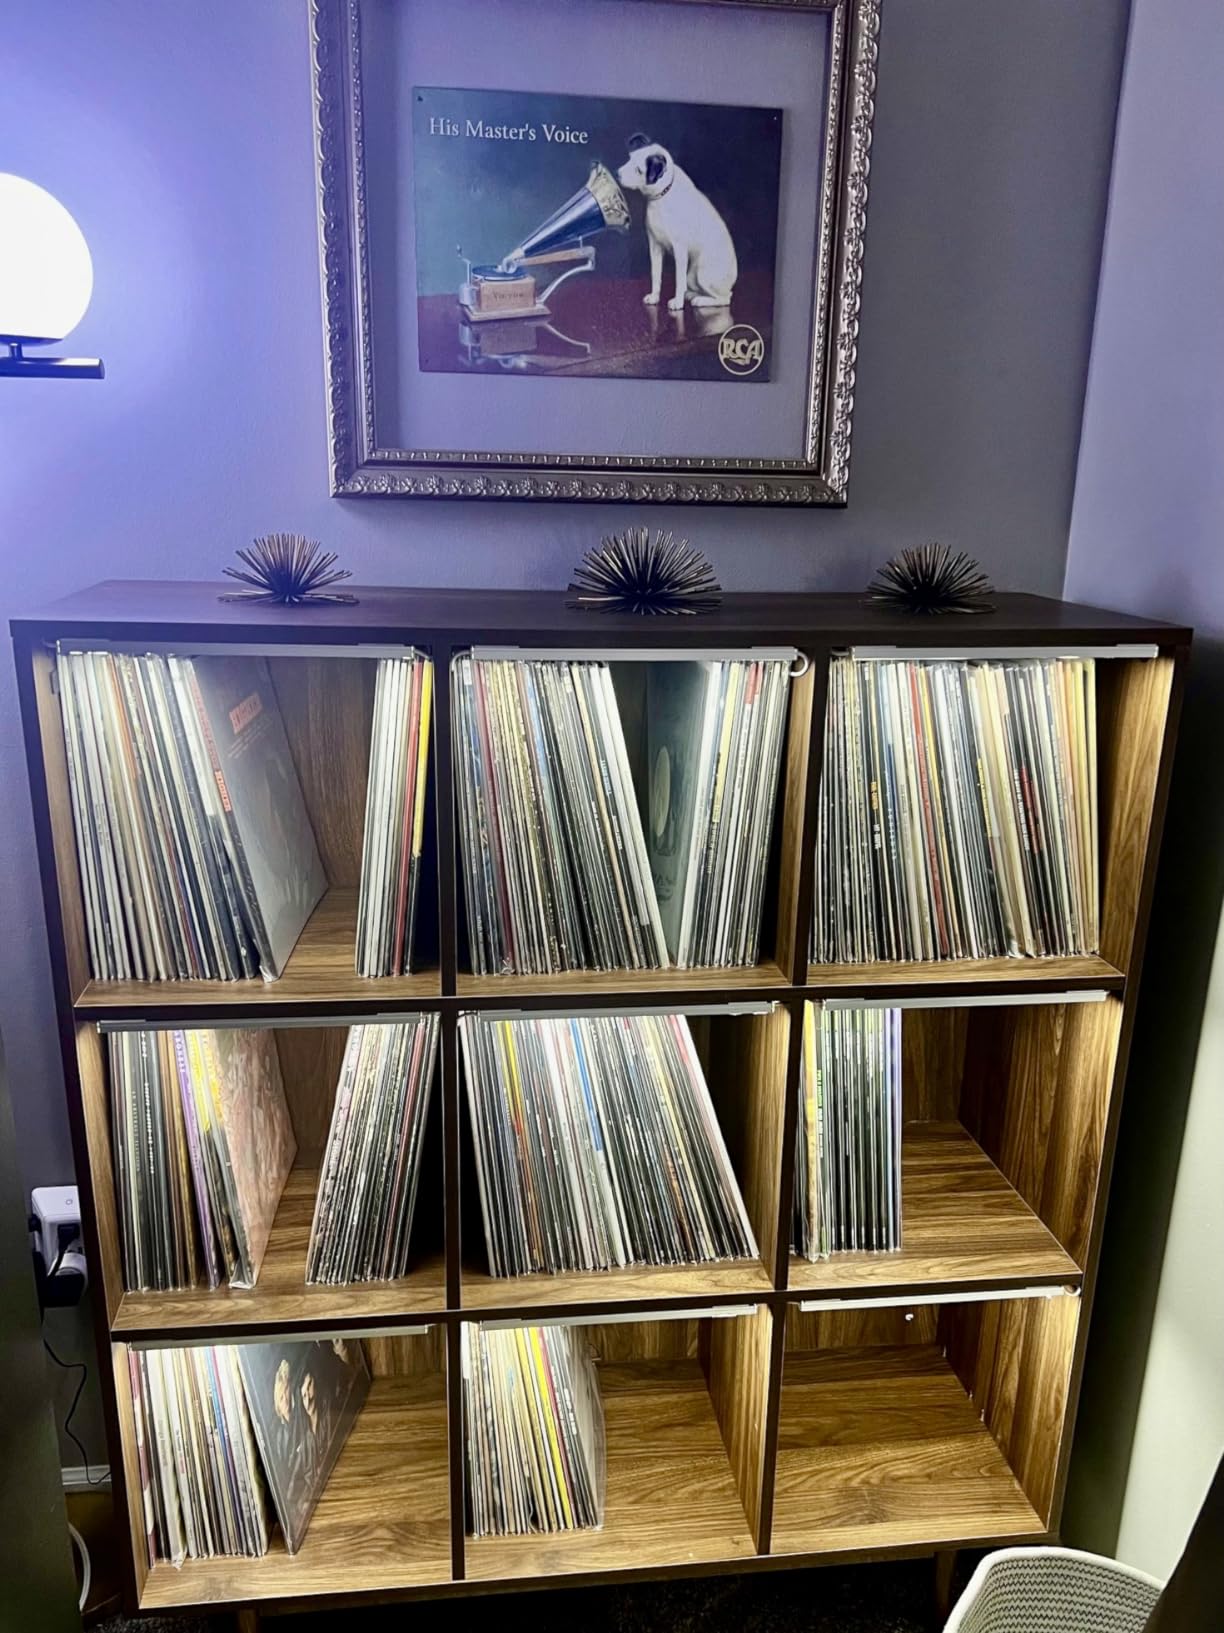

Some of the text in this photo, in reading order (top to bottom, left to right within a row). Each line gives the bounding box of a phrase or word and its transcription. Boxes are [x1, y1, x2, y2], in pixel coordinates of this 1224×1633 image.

[429, 117, 588, 144] His Master's Voice
[722, 338, 761, 365] RCA
